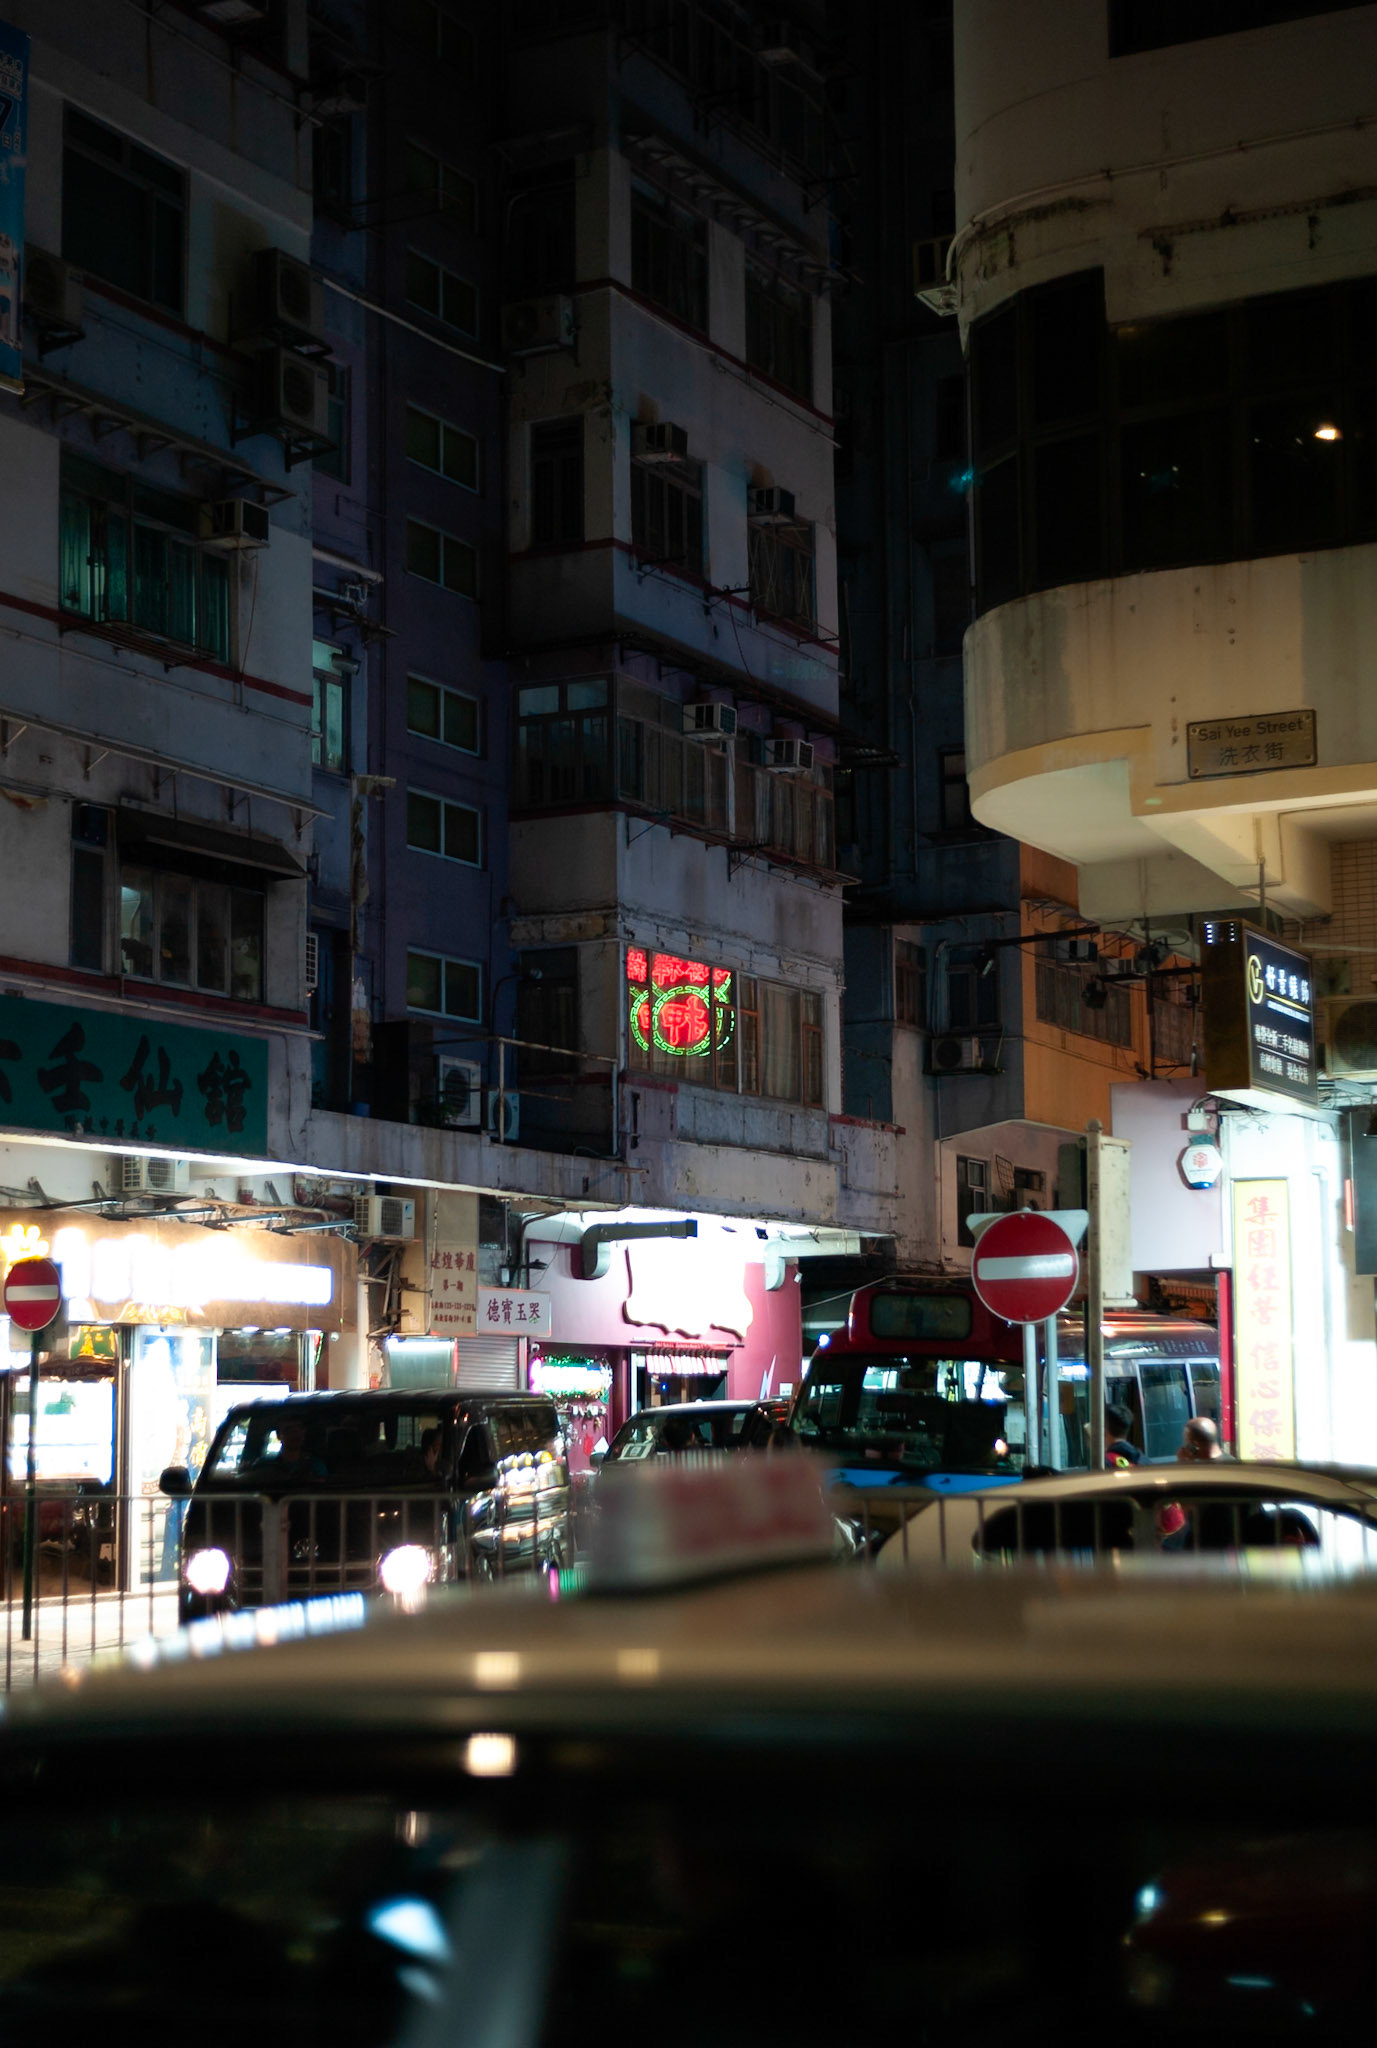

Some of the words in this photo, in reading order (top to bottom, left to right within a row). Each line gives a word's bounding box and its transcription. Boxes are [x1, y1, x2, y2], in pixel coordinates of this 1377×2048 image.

[1198, 728, 1221, 742] Sai
[1226, 725, 1251, 739] Yee
[1256, 717, 1304, 735] Street
[1219, 742, 1285, 767] 洗衣街
